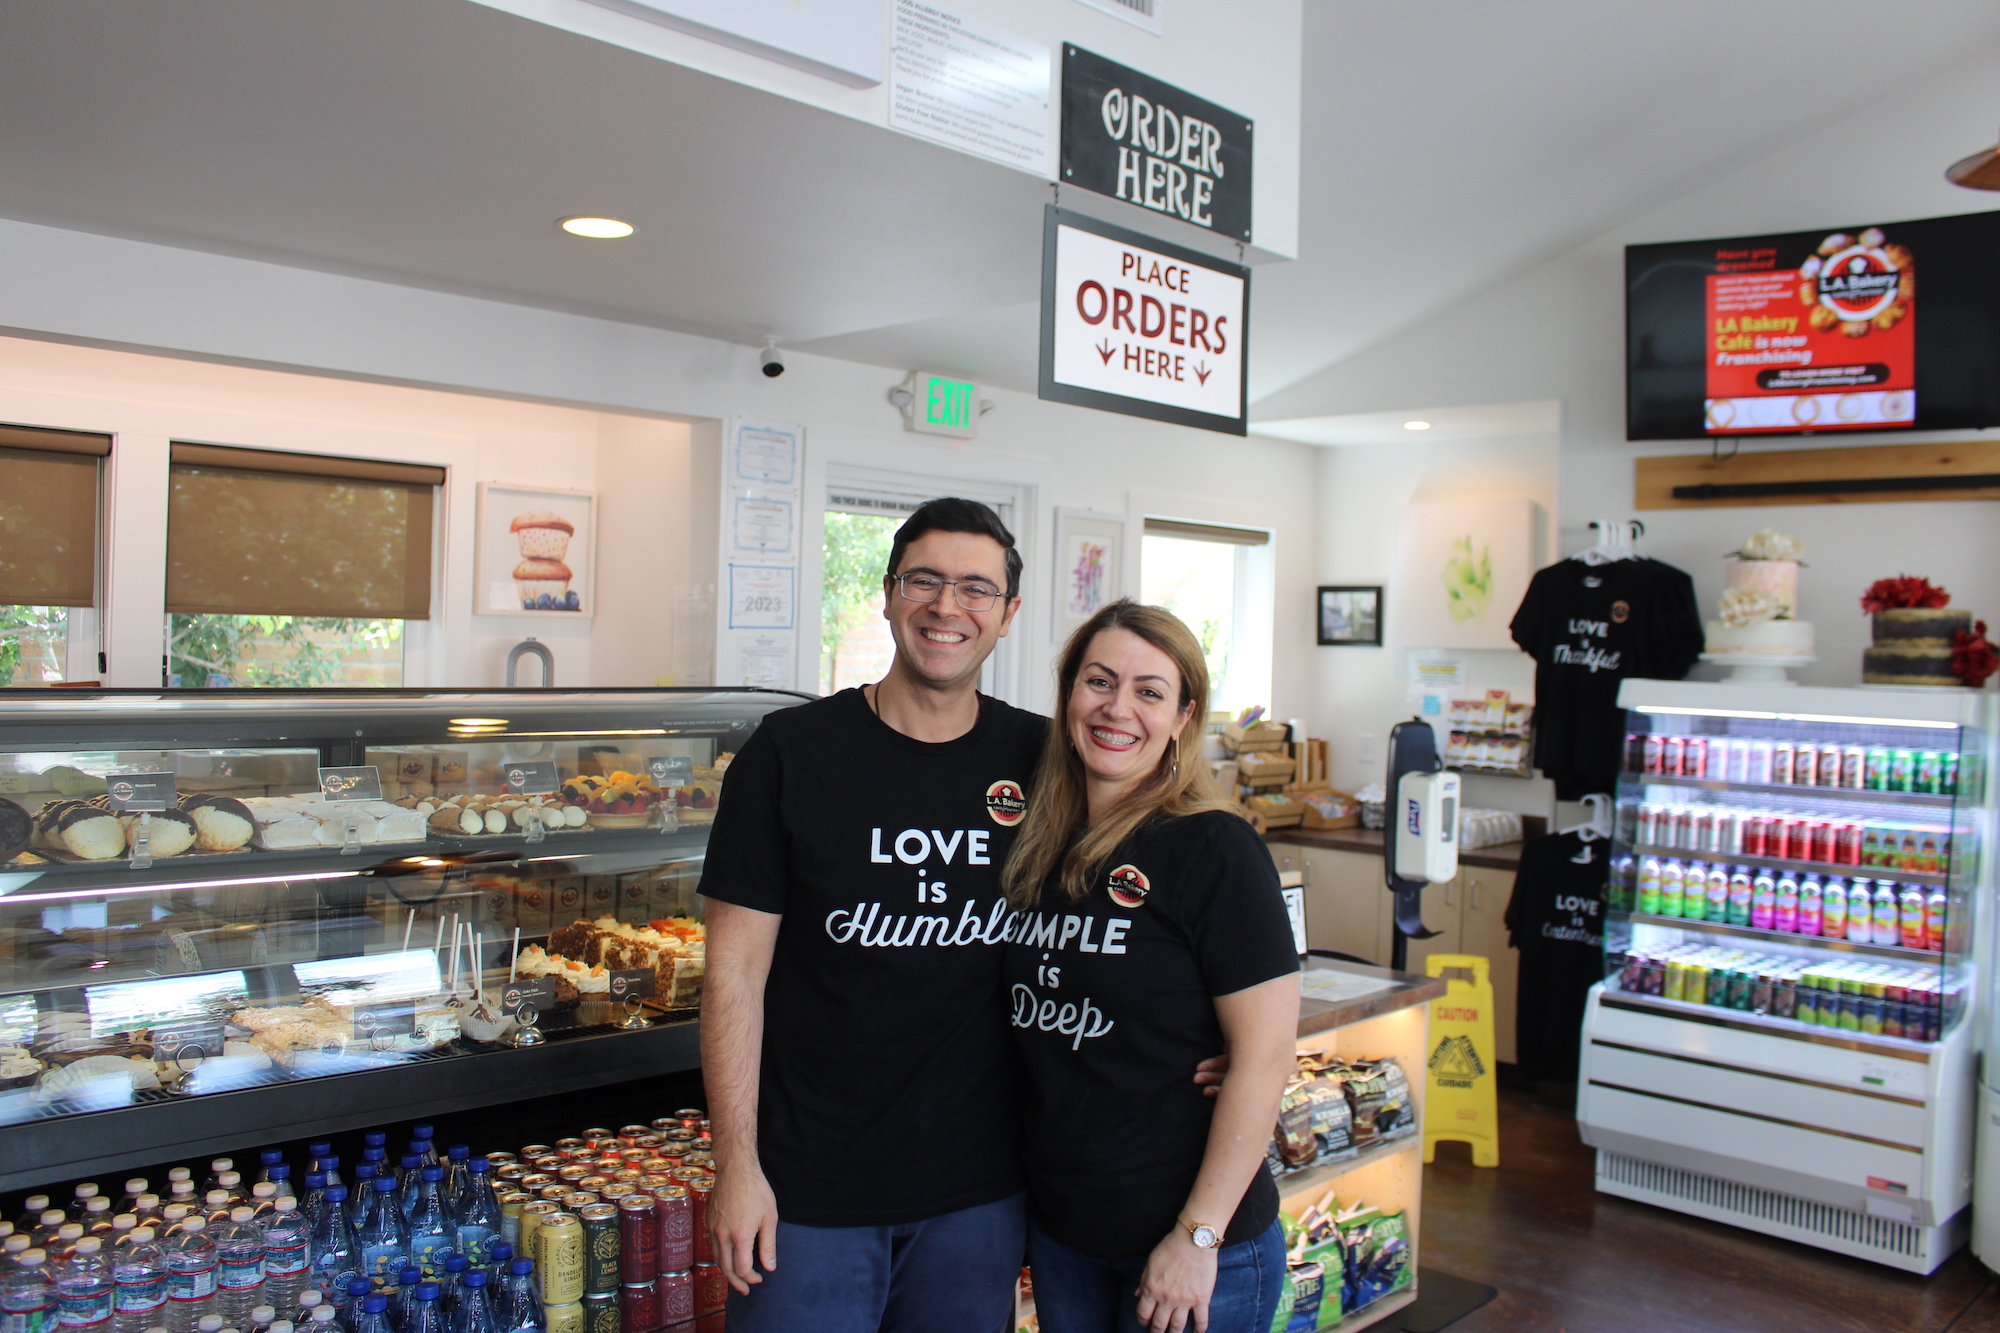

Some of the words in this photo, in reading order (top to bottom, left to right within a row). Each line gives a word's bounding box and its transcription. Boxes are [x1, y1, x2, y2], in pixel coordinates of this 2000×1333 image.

[1101, 87, 1224, 179] ORDER
[1116, 145, 1214, 227] HERE
[1122, 251, 1190, 294] PLACE
[1850, 274, 1898, 289] Bakery
[1077, 280, 1227, 355] ORDERS
[1716, 318, 1738, 333] LA
[1741, 315, 1799, 334] Bakery
[1716, 334, 1753, 351] Café
[1755, 335, 1769, 349] is
[1771, 336, 1807, 349] now
[1124, 343, 1185, 382] HERE
[1716, 350, 1813, 367] Franchising
[927, 377, 974, 429] EXIT
[745, 596, 781, 612] 2023
[1568, 618, 1609, 638] LOVE
[1553, 644, 1621, 673] Thankful
[1002, 797, 1026, 810] Bakery
[870, 827, 991, 866] LOVE
[917, 868, 948, 904] is
[1555, 894, 1600, 916] LOVE
[1571, 911, 1585, 927] is
[1012, 910, 1132, 955] IMPLE
[1038, 953, 1061, 989] is
[1011, 983, 1114, 1051] Deep
[1437, 1006, 1479, 1022] CAUTION
[1437, 1078, 1474, 1089] CUIDADO
[601, 1266, 618, 1275] LEMON
[602, 1261, 617, 1269] BLACK
[564, 1273, 581, 1282] GINGER
